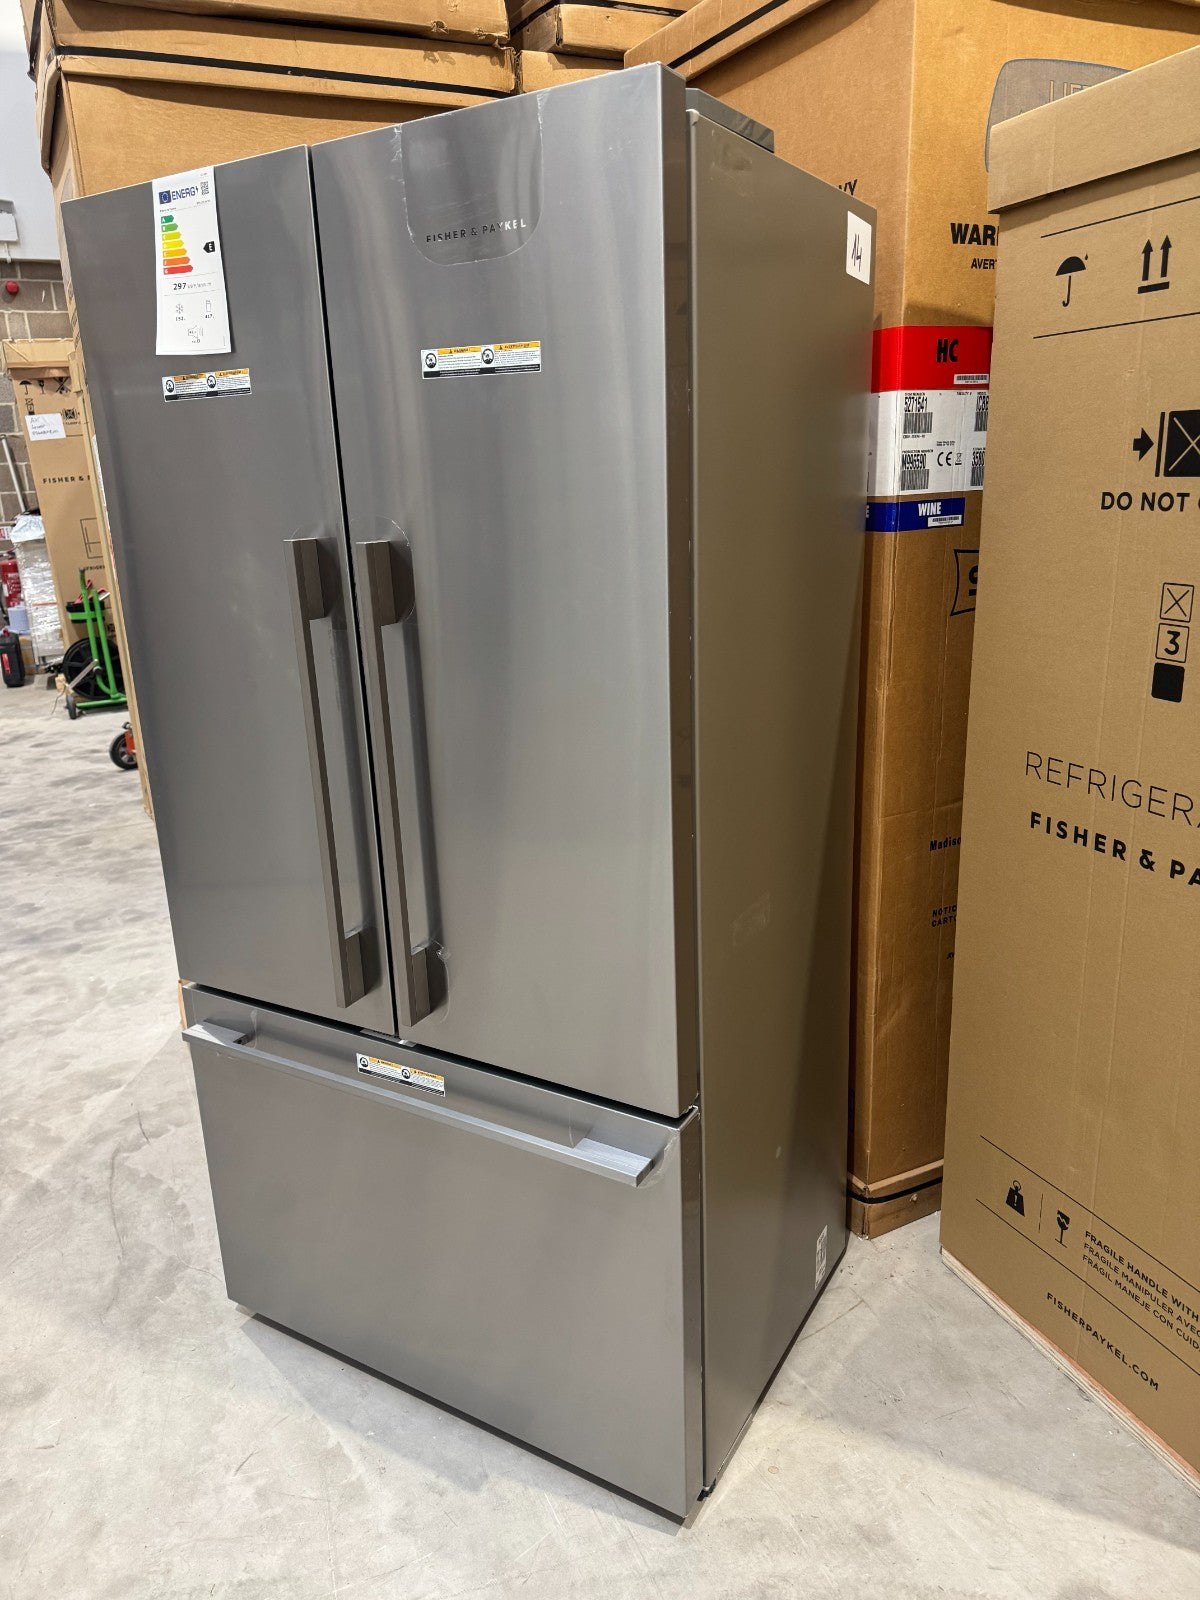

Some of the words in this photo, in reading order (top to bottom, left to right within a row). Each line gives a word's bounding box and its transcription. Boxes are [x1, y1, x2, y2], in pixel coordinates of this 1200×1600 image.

[172, 186, 196, 200] ENERG
[426, 229, 466, 242] FISHER
[471, 227, 478, 236] &
[482, 219, 527, 234] PAYKEL
[950, 222, 998, 246] WAR
[173, 282, 187, 290] 297
[936, 338, 959, 362] HC
[904, 396, 928, 412] 5271541
[43, 476, 75, 484] FISHER
[918, 502, 942, 517] WINE
[1101, 492, 1133, 511] DO
[1140, 492, 1190, 512] NOT
[1163, 630, 1181, 656] 3
[1025, 751, 1200, 828] REFRIGER
[1030, 811, 1127, 861] FISHER
[1139, 848, 1156, 872] &
[1083, 1243, 1120, 1274] FRAGILE
[1121, 1271, 1174, 1316] MANIPULER
[1084, 1230, 1125, 1266] FRAGILE
[1126, 1261, 1168, 1298] HANDLE
[1171, 1294, 1199, 1322] WITH
[1082, 1255, 1113, 1283] FRAGIL
[1114, 1279, 1151, 1312] MANEJE
[1152, 1309, 1174, 1330] CON
[1175, 1327, 1200, 1351] CUID
[1046, 1292, 1159, 1391] FISHERPAYKEL.COM
